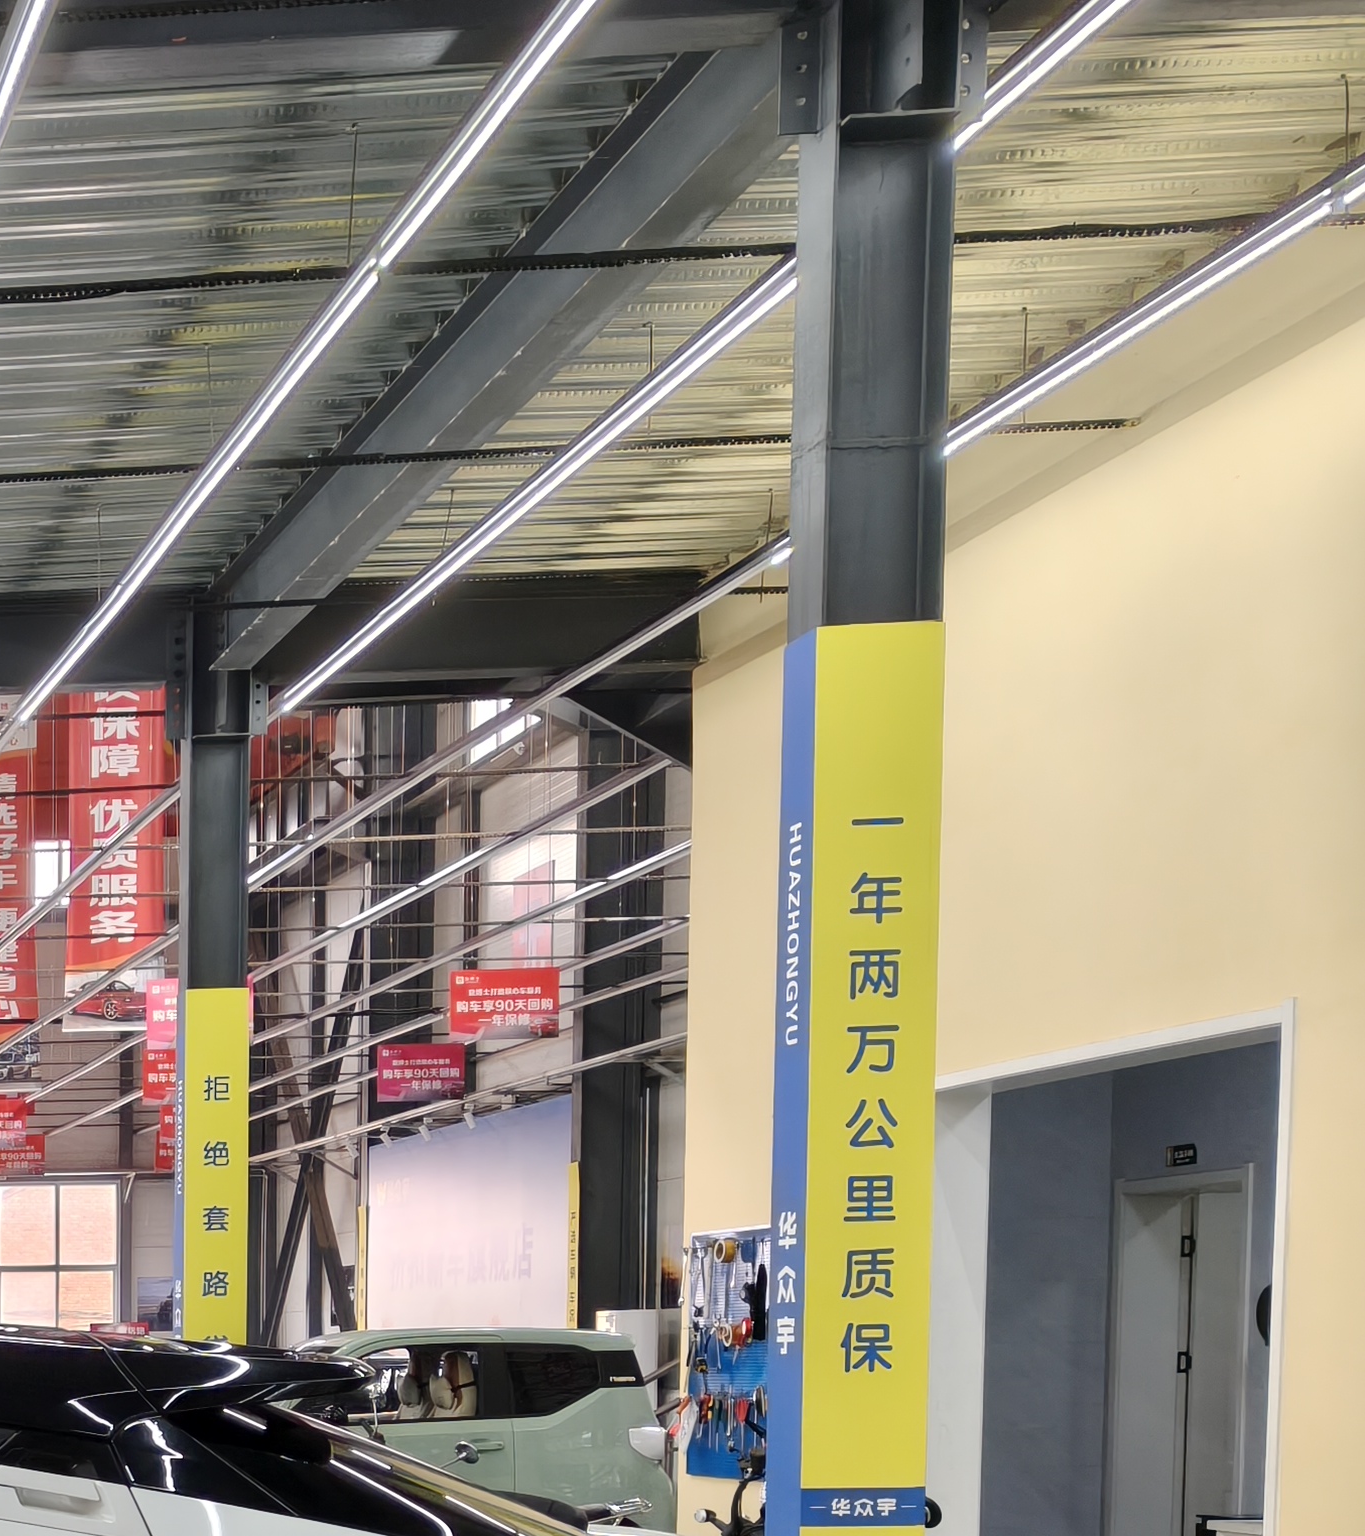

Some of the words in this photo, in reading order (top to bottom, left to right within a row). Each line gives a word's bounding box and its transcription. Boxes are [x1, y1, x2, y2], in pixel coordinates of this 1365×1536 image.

[455, 999, 554, 1012] 购车享90天回购
[784, 822, 803, 1046] HUAZHONGYU
[382, 1068, 460, 1080] 购车享90天回购
[839, 815, 904, 1374] 一年两万公里质保
[202, 1074, 231, 1342] 拒绝套路
[776, 1211, 798, 1355] 华众宇
[830, 1497, 898, 1517] 华众宇
